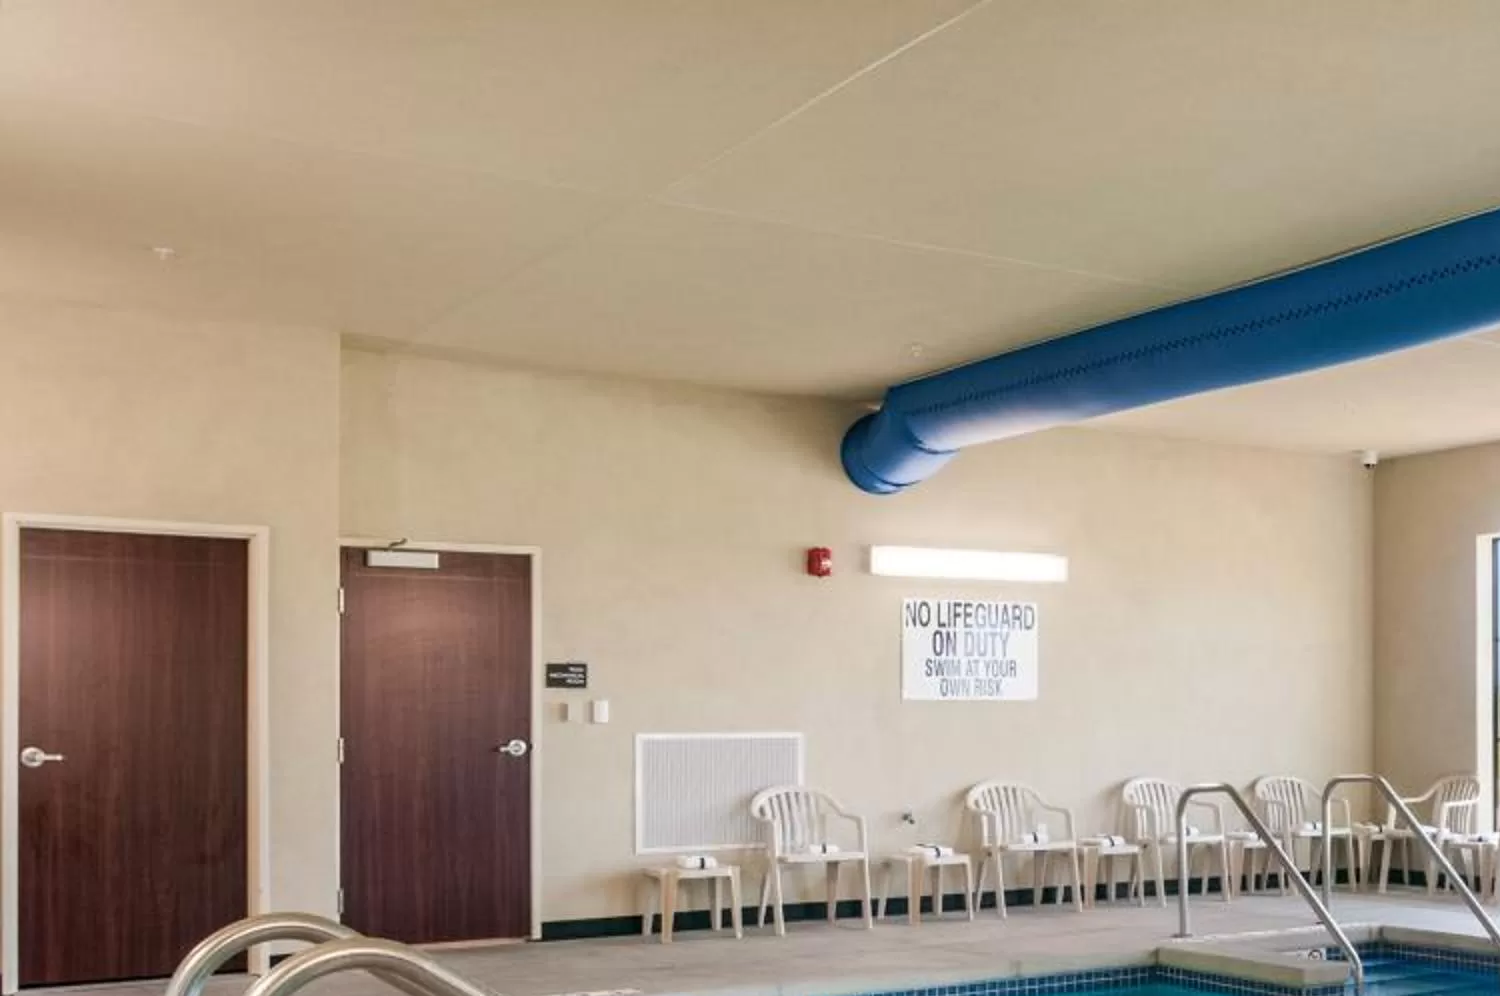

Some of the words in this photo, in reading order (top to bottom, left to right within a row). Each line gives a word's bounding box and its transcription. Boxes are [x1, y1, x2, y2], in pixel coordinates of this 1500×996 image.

[905, 601, 931, 628] NO
[937, 602, 1035, 630] LIFEGUARD
[932, 630, 957, 657] ON
[963, 631, 1010, 657] DUTY
[925, 659, 961, 677] SWIM
[966, 659, 980, 677] AT
[984, 659, 1017, 677] YOUR
[939, 678, 970, 697] OWN
[974, 678, 1003, 697] RISK
